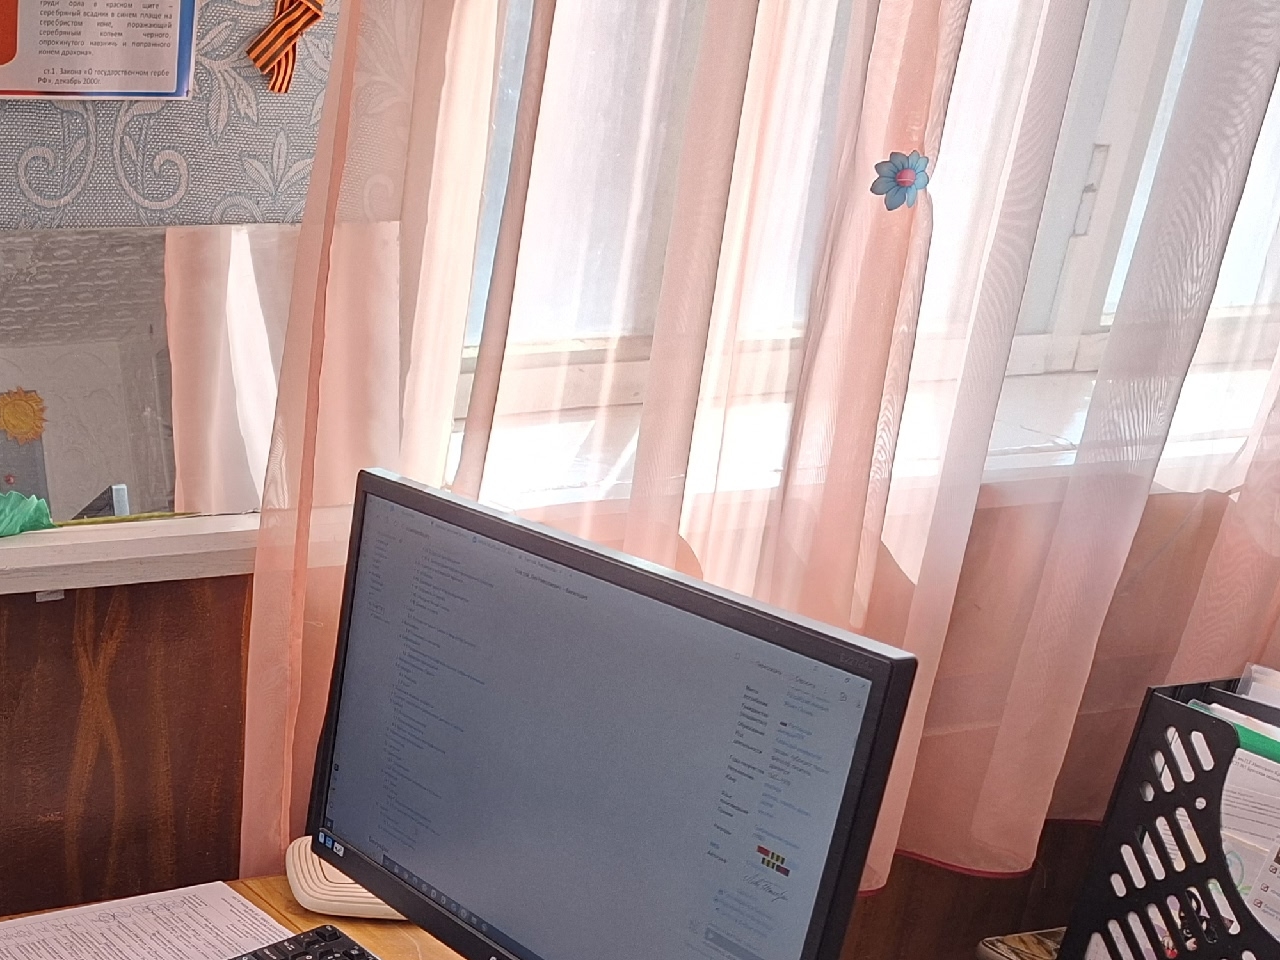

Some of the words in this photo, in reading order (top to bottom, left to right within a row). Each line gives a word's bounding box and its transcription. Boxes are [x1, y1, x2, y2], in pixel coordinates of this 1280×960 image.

[39, 9, 81, 17] серебряный
[39, 19, 84, 27] серебристом
[39, 29, 82, 37] серебряным
[142, 32, 171, 40] черного,
[60, 67, 82, 75] Закона
[95, 69, 149, 77] государственном
[151, 69, 170, 77] гербе
[54, 77, 82, 86] декабрь
[82, 77, 102, 85] 2000г.
